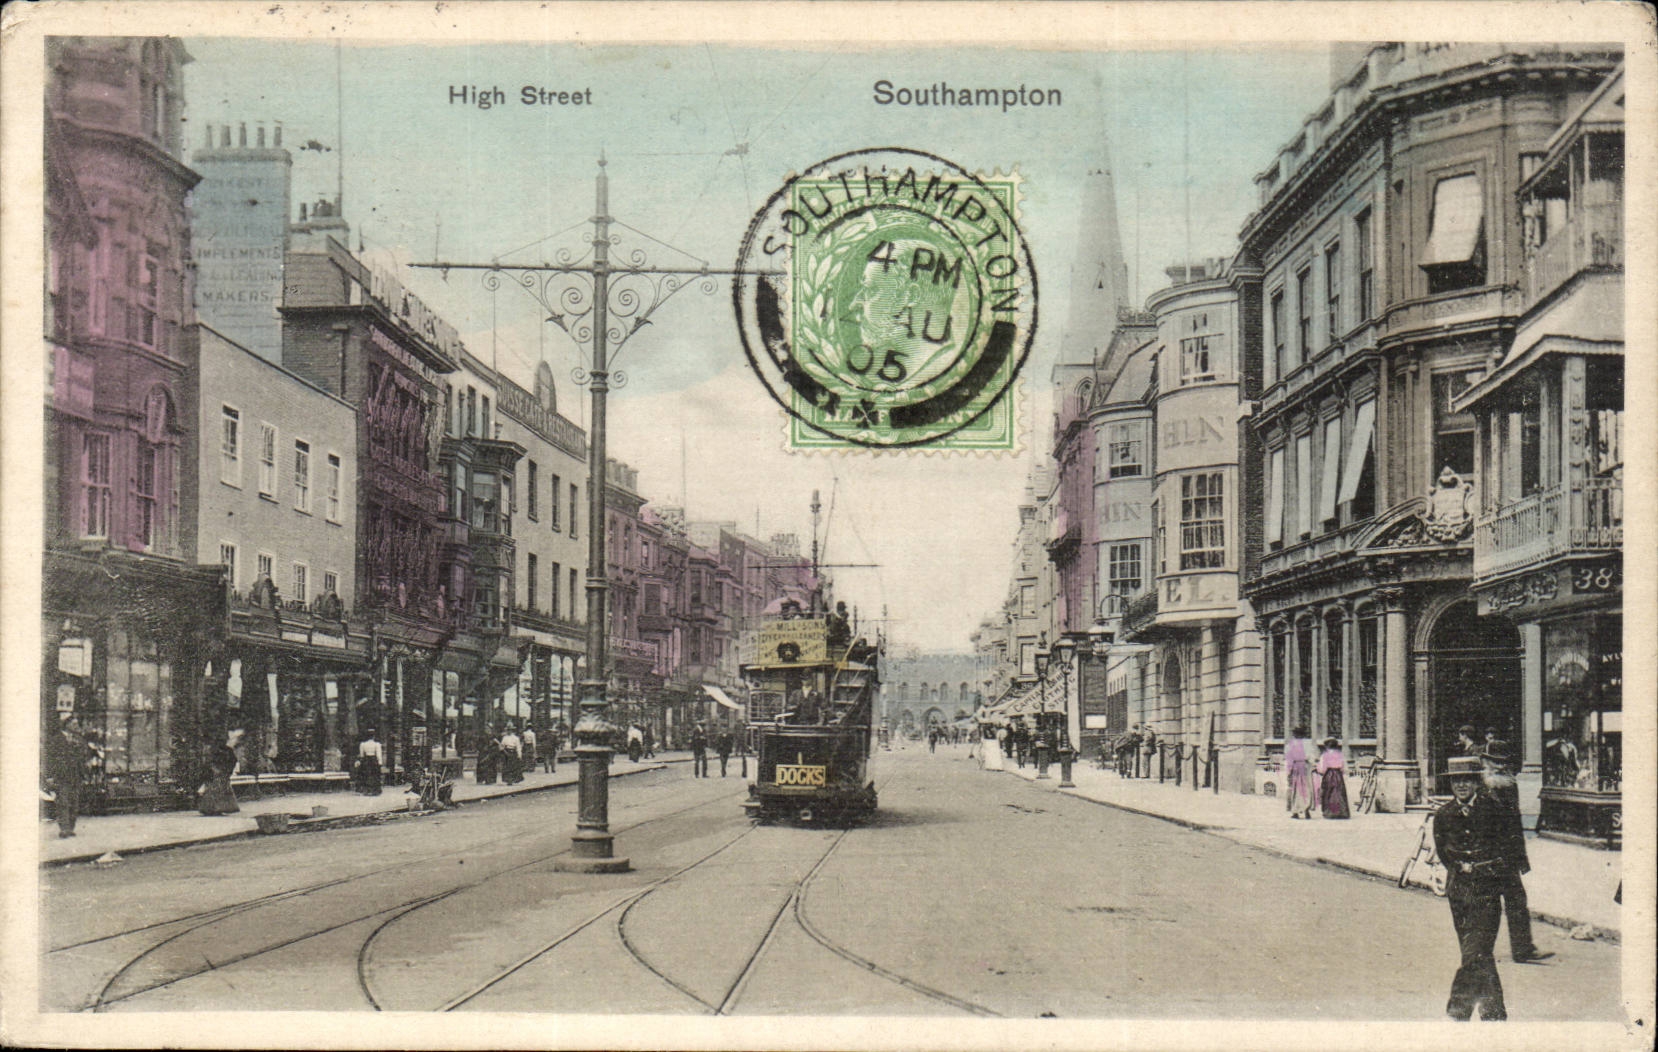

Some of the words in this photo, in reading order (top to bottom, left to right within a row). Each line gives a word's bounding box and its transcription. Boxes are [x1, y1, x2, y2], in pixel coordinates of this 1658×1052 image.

[197, 246, 281, 259] IMPLEMENTS
[1575, 567, 1613, 590] 38
[777, 767, 824, 785] DOCKS
